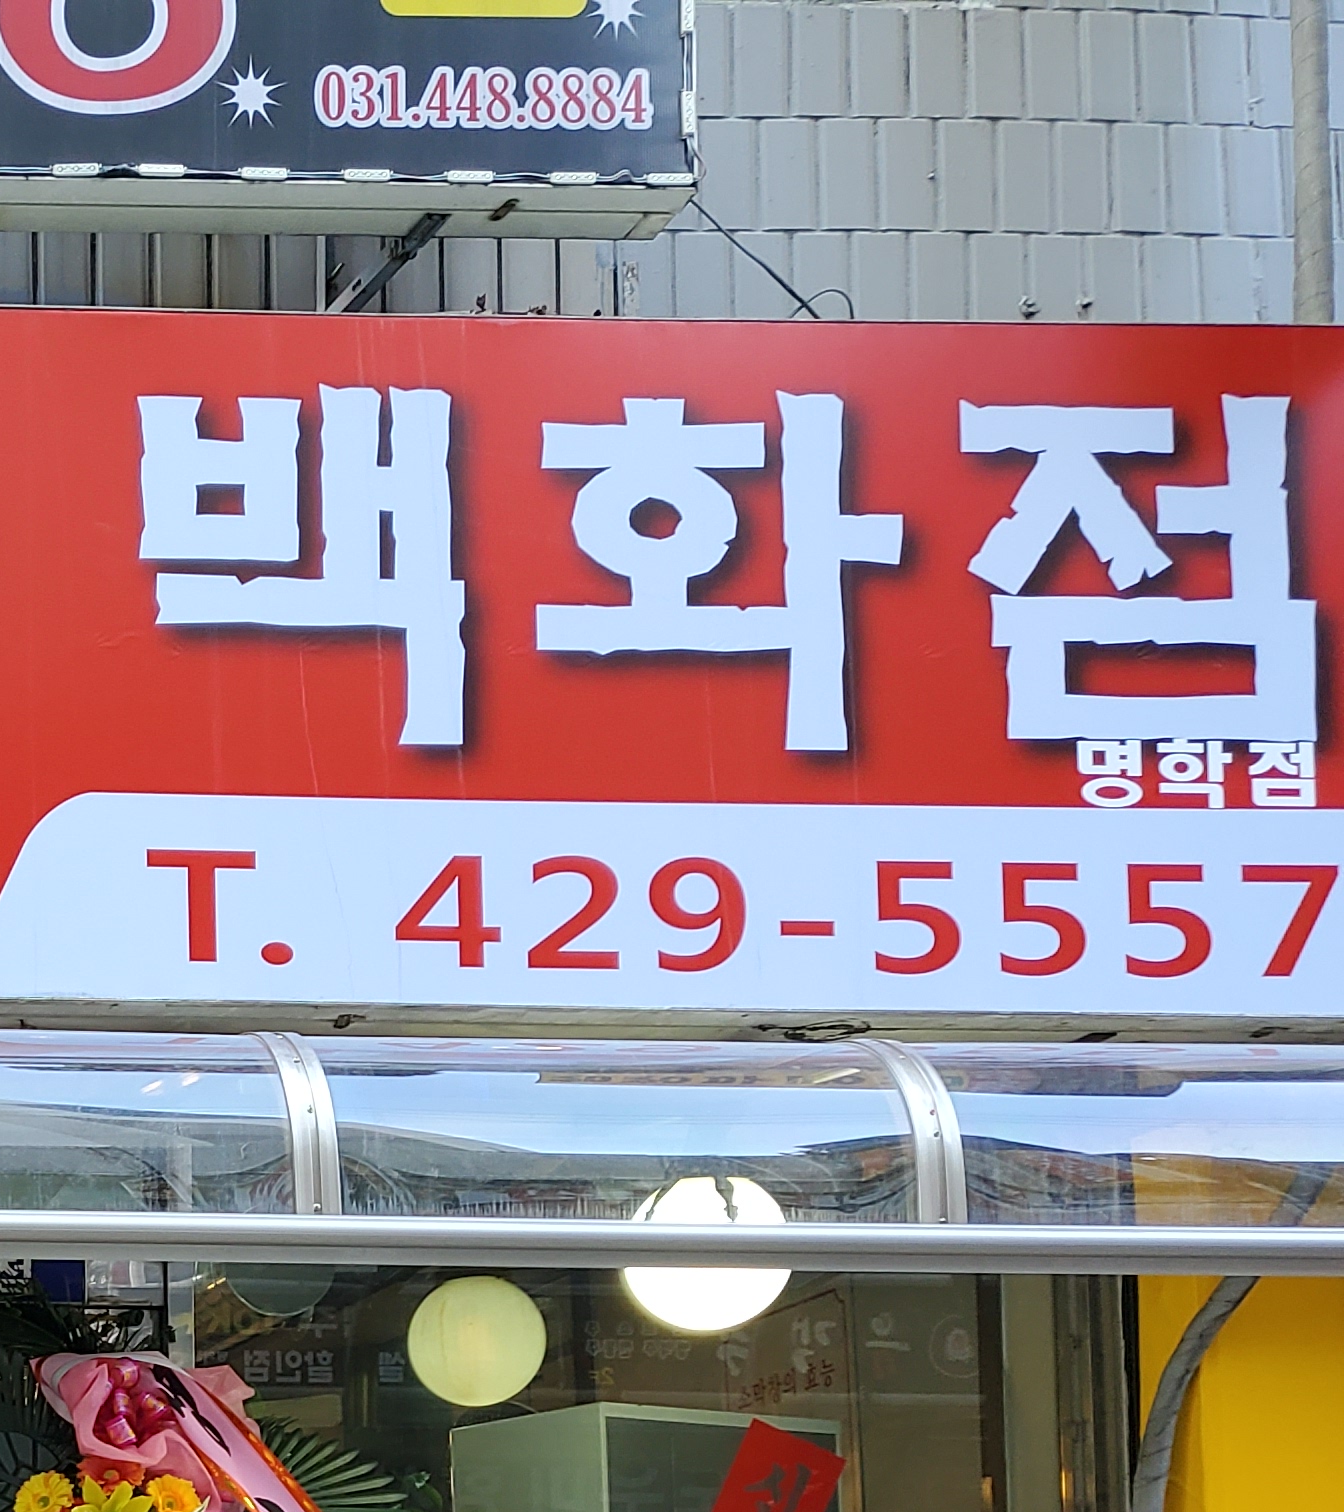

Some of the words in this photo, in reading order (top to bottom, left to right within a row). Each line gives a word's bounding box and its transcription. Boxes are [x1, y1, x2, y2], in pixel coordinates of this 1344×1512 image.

[314, 66, 652, 130] 031.448.8884
[136, 384, 1318, 754] 백화점
[1075, 738, 1318, 810] 명학점
[144, 848, 296, 968] T.
[394, 852, 1340, 979] 429-5557
